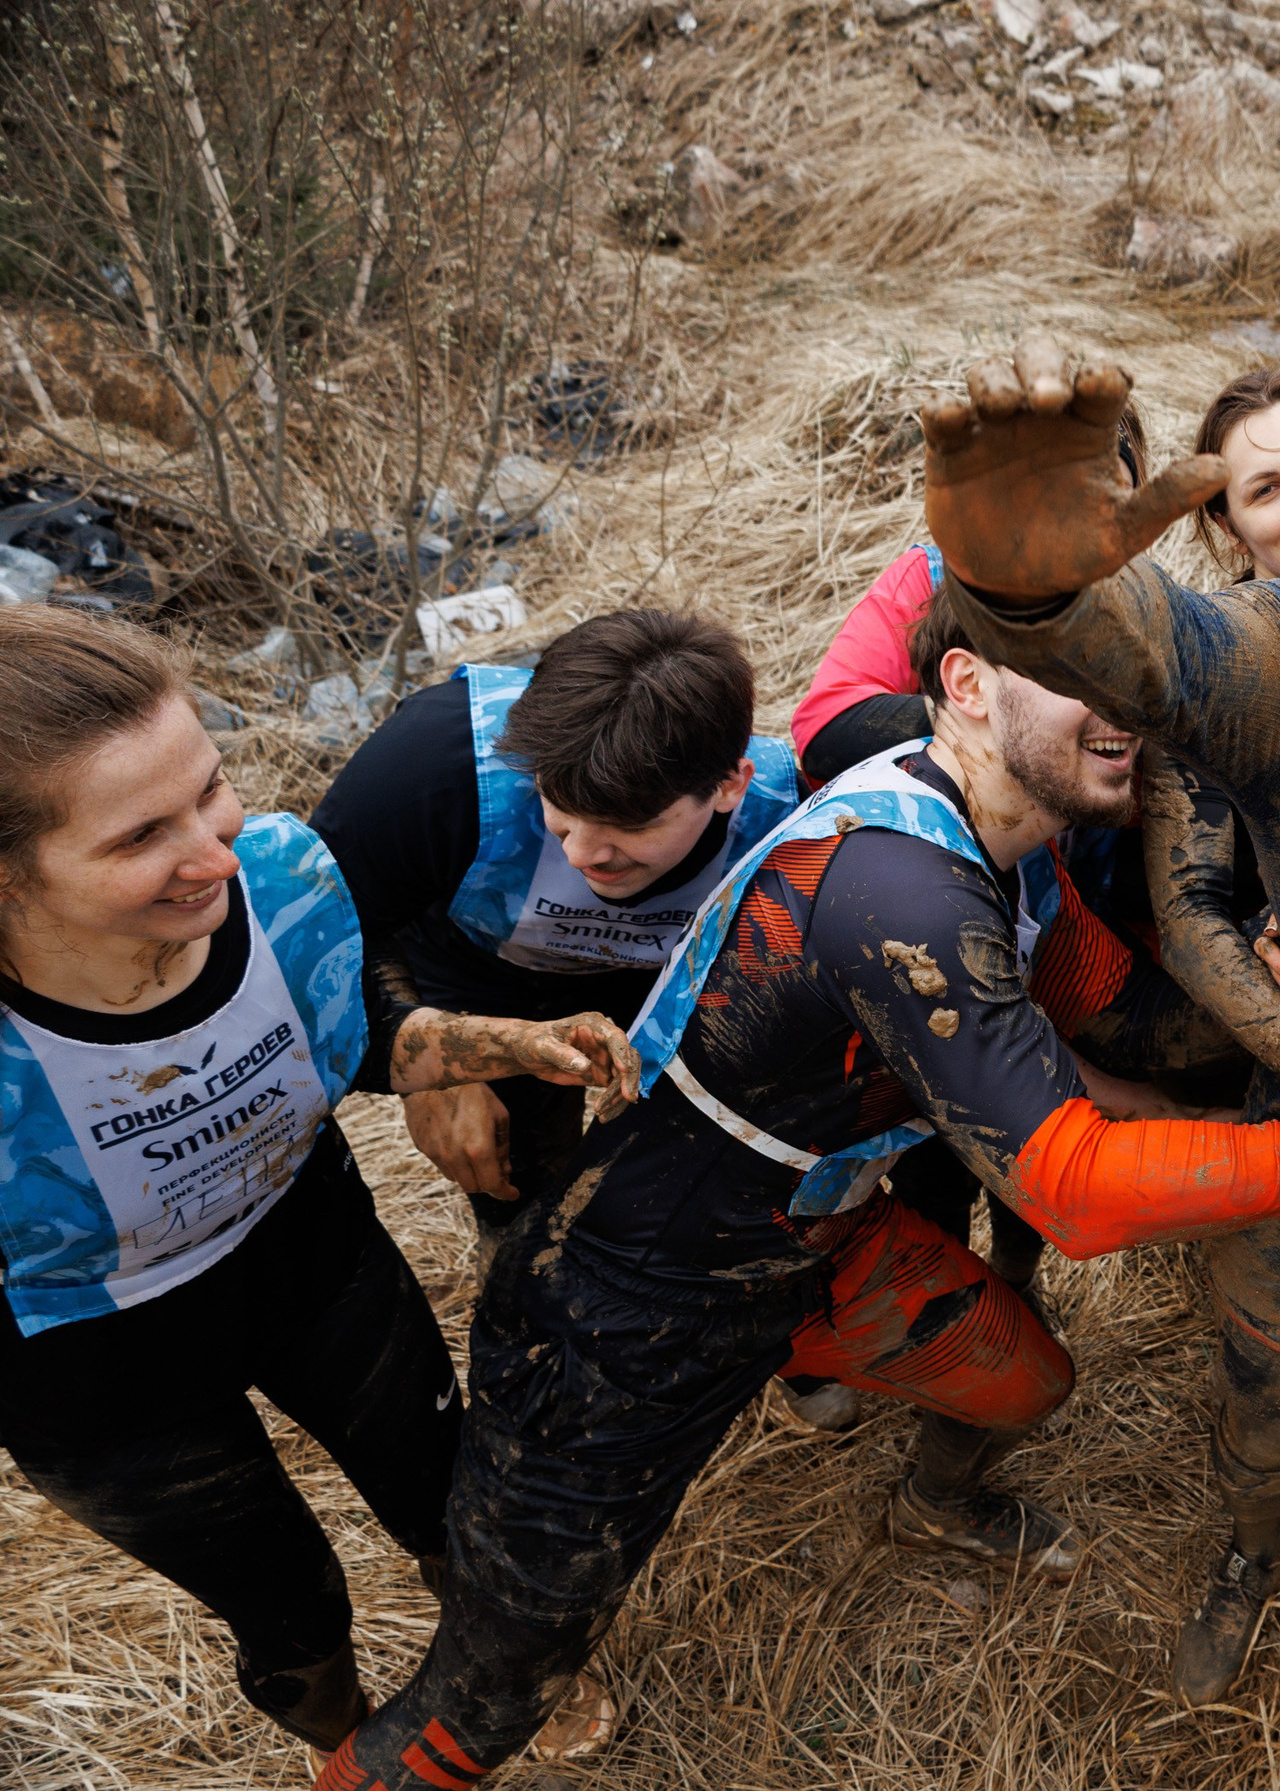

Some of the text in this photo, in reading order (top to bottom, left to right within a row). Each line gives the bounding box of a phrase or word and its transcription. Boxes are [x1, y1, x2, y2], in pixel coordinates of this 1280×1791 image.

[535, 897, 610, 919] ГОНКА
[551, 921, 668, 952] Sminex
[545, 941, 661, 965] ПЕРФЕКЦОНИСТЫ
[90, 1021, 294, 1144] ГОНКА ГЕРОЕВ
[142, 1078, 289, 1173] Sminex
[157, 1108, 296, 1196] ПЕРФЕКЦИОНИСТЫ
[162, 1183, 197, 1207] FINE
[201, 1120, 297, 1185] DEVELOPMENT
